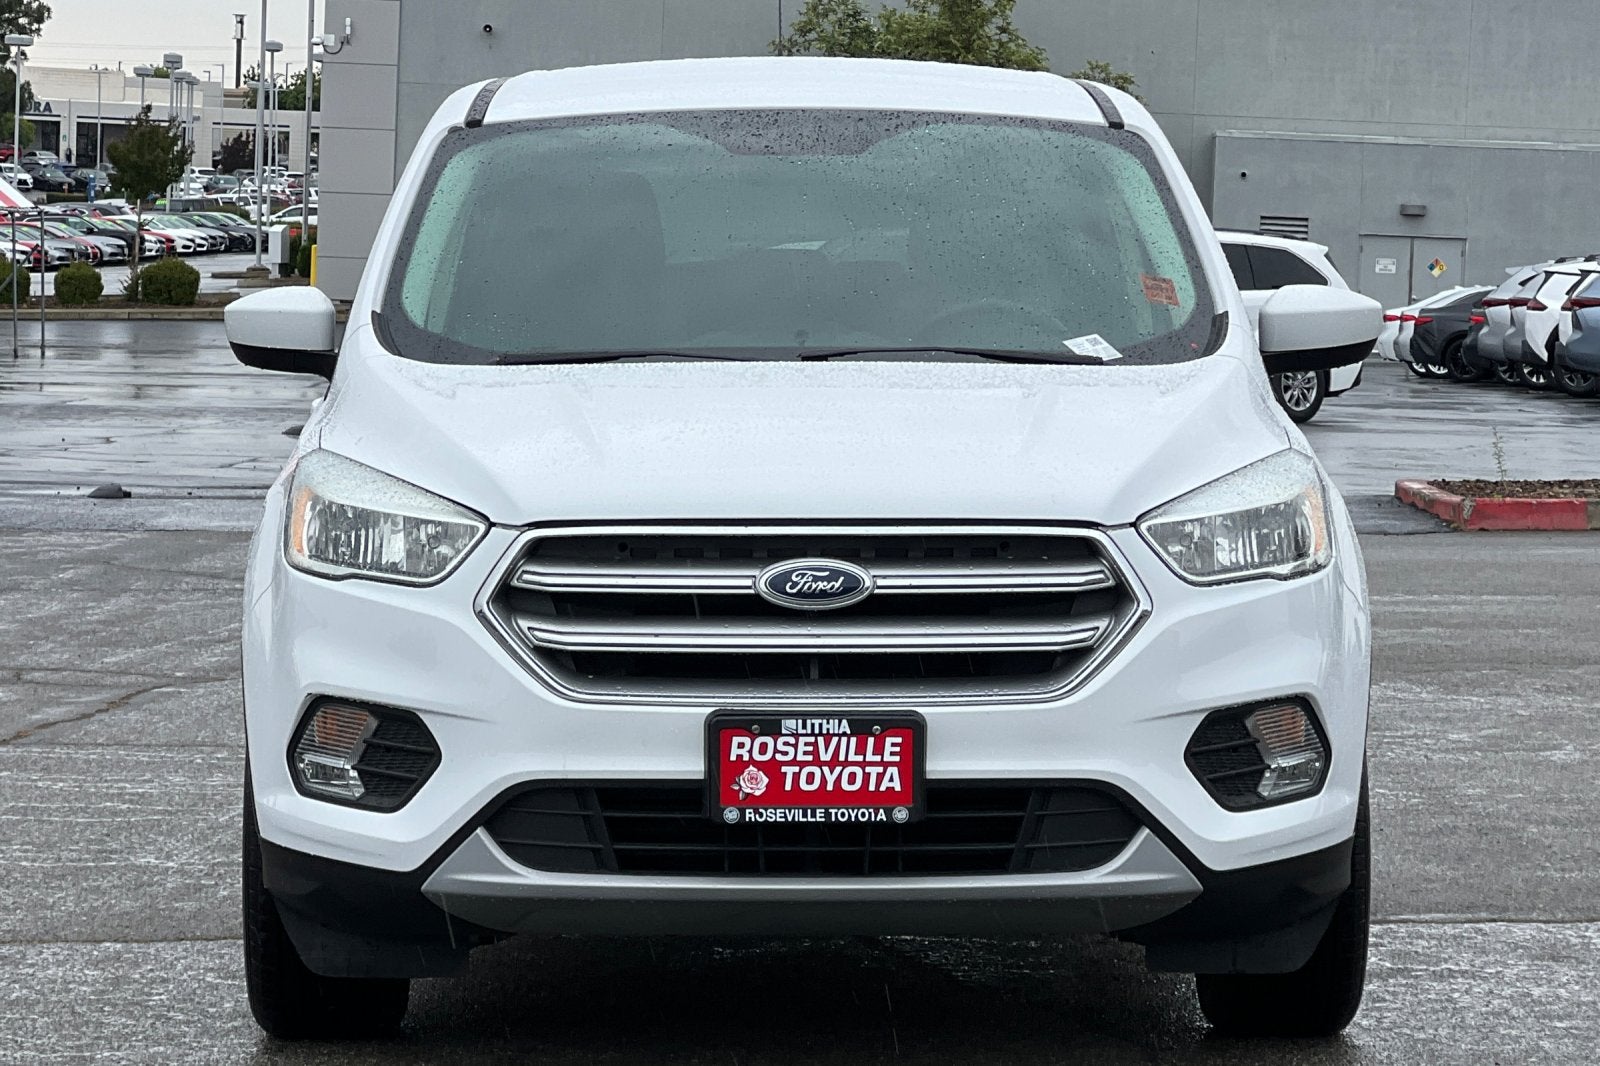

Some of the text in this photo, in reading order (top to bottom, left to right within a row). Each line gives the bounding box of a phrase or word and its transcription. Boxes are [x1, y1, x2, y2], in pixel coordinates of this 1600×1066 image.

[785, 570, 844, 594] Ford
[798, 719, 851, 734] LITHIA
[730, 736, 903, 762] ROSEVILLE
[781, 766, 902, 792] TOYOTA
[745, 808, 887, 822] ROSEVILLE TOYOTA
